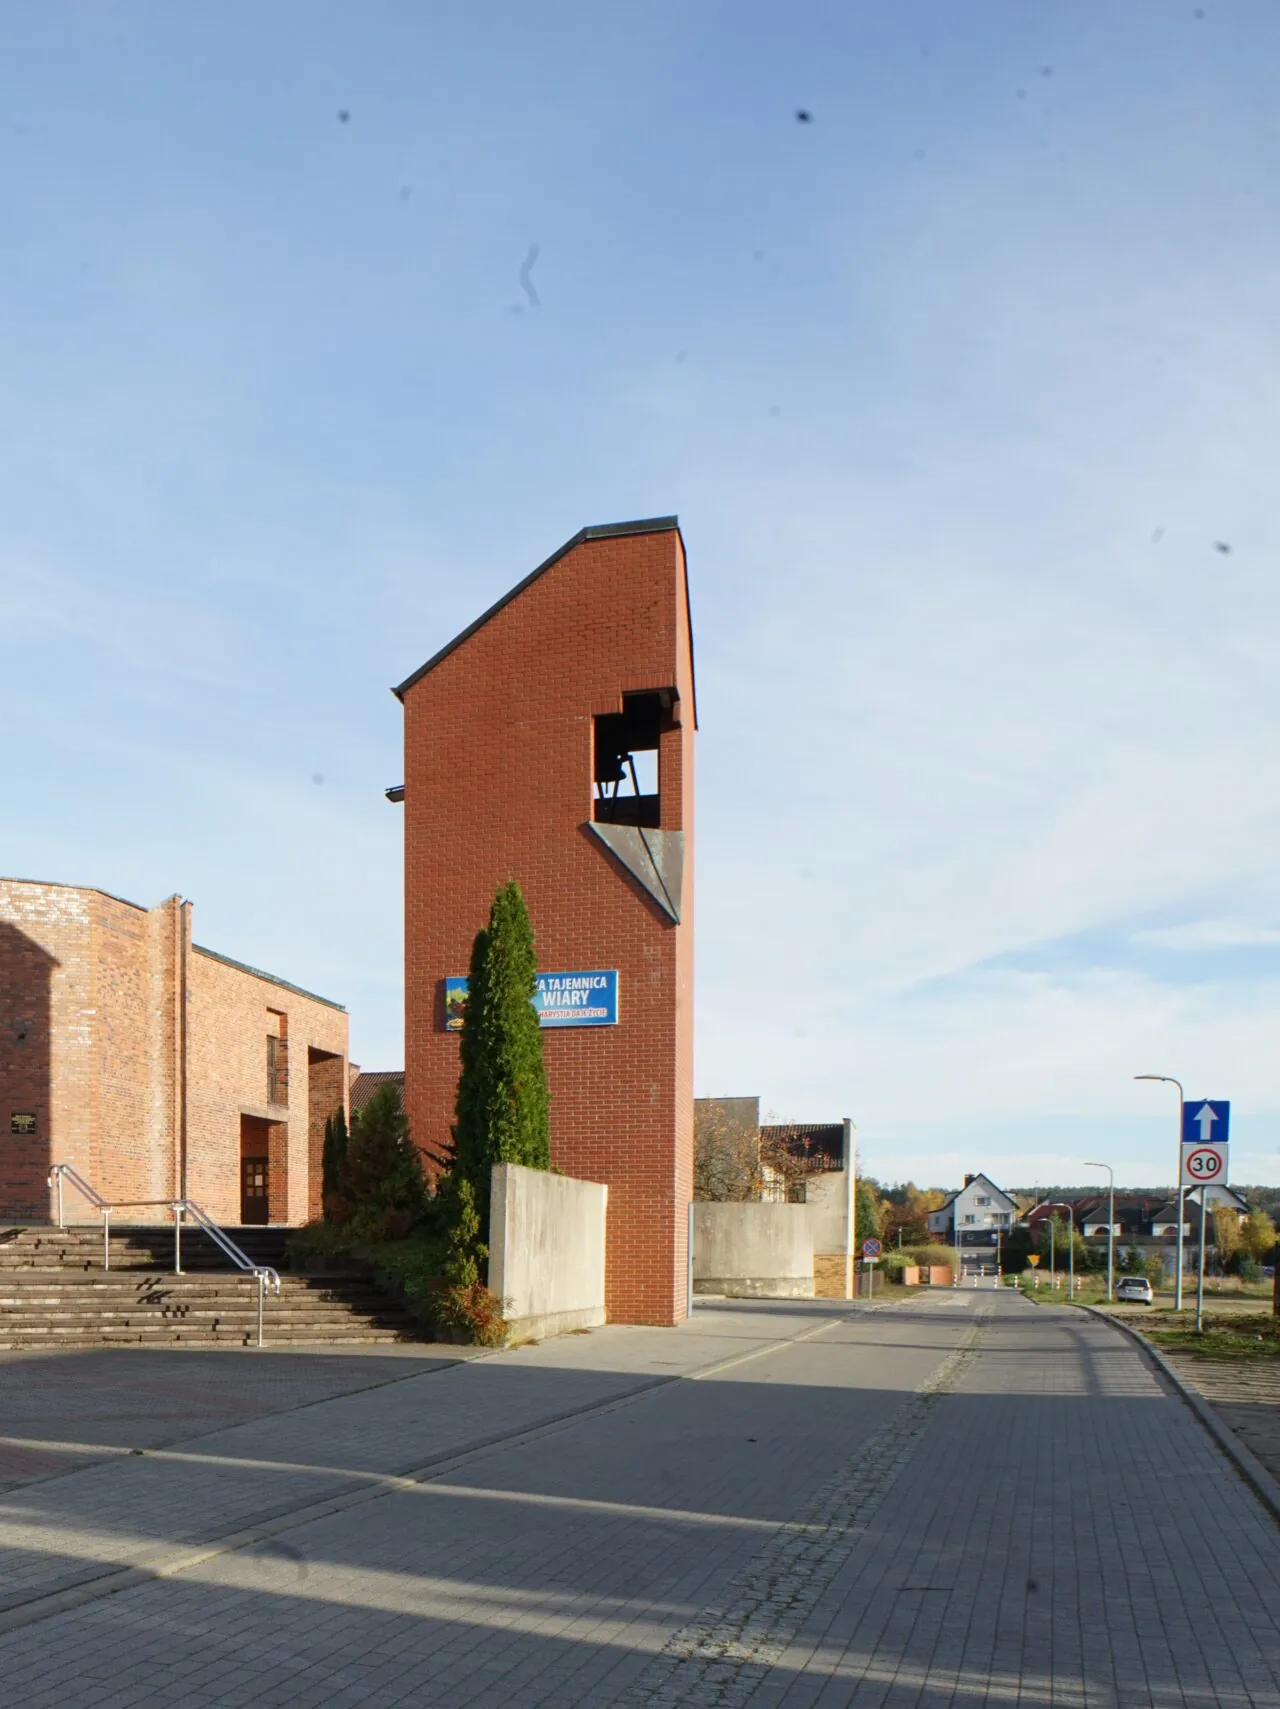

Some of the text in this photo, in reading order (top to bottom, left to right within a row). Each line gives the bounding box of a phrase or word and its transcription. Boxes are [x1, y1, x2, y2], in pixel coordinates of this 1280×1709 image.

[547, 976, 608, 991] TAJEMNICA
[542, 990, 590, 1006] WIARY
[539, 1010, 571, 1018] HARYSTIA
[1192, 1157, 1217, 1172] 30
